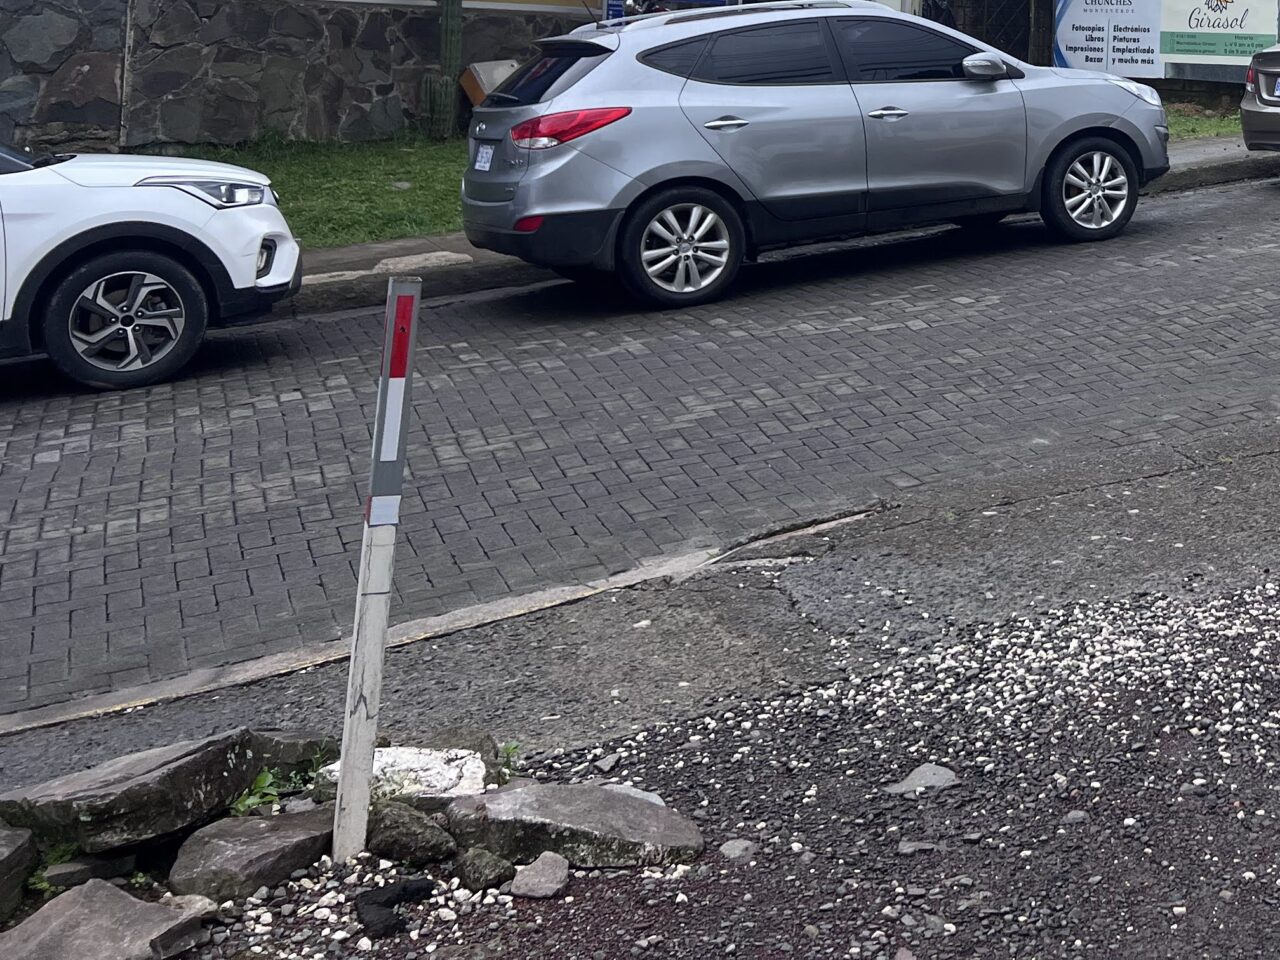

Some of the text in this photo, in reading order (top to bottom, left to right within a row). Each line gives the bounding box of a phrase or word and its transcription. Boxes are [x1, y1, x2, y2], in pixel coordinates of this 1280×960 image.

[1188, 6, 1249, 29] Girasol
[1071, 24, 1105, 33] Fotocopias
[1113, 24, 1150, 33] Electrónicos
[1085, 34, 1105, 42] Libros
[1112, 35, 1140, 43] Pinturas
[1065, 44, 1104, 54] Impresiones
[1112, 45, 1155, 55] Emplasticado
[1085, 54, 1104, 63] Bazar
[1111, 56, 1154, 65] y mucho más
